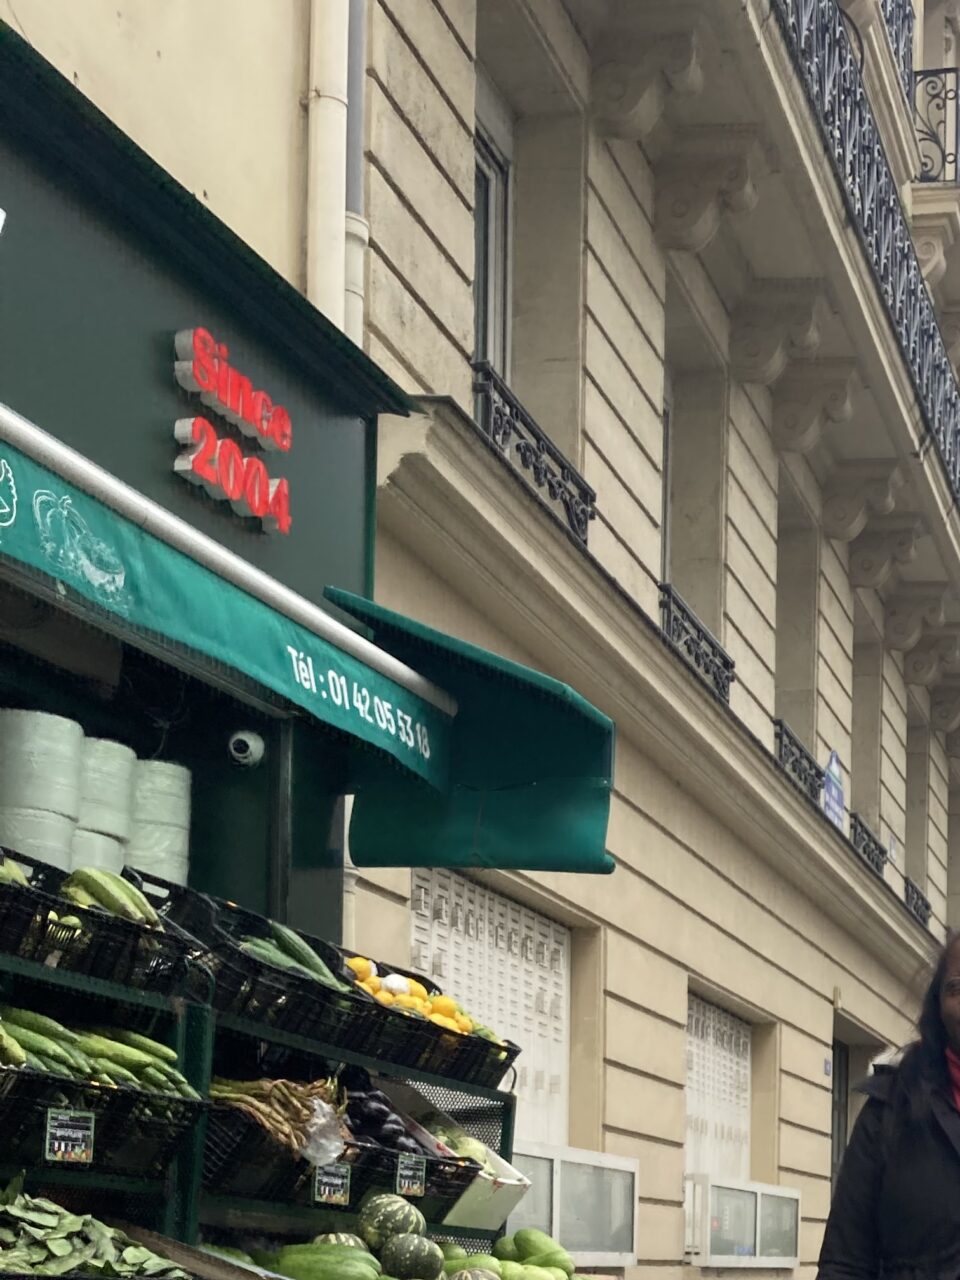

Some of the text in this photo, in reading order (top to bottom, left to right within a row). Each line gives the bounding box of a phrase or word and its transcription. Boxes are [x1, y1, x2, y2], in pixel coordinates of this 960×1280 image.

[190, 326, 292, 452] Since
[188, 415, 292, 534] 2004
[286, 645, 317, 693] Tél
[327, 669, 350, 710] 01
[352, 682, 374, 723] 42
[373, 695, 396, 735] 05
[396, 708, 415, 748] 53
[415, 722, 431, 759] 18
